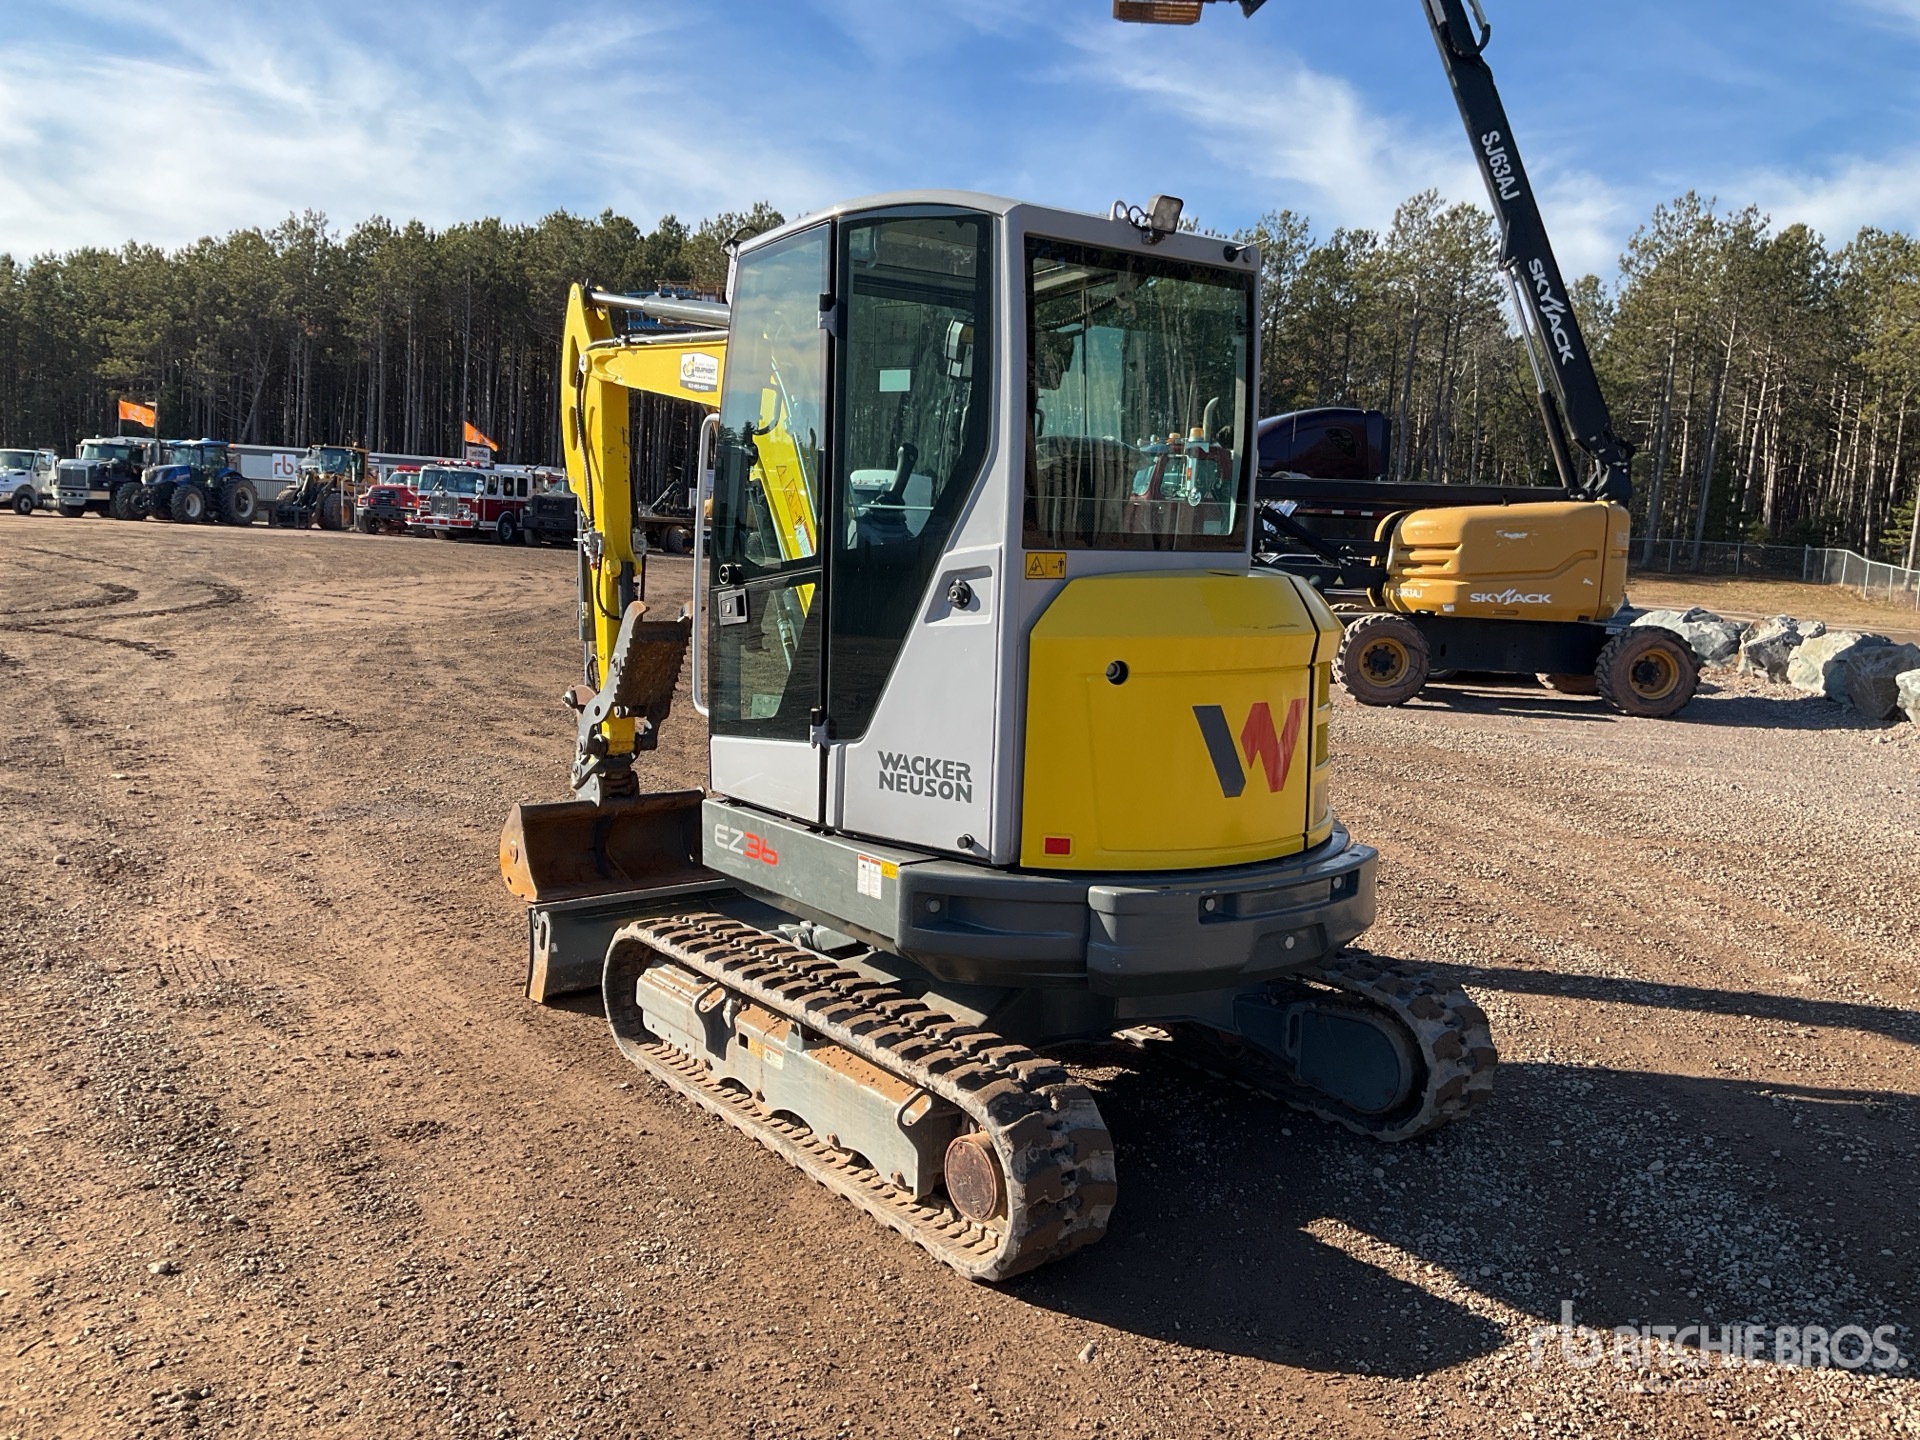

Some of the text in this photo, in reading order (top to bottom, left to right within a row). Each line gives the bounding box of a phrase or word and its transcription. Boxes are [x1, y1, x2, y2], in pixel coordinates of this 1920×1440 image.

[1481, 130, 1520, 201] SJ63AJ
[1528, 257, 1575, 366] SKYJACK
[274, 455, 294, 476] rb
[1470, 588, 1552, 605] SKYJACK
[877, 750, 973, 783] WACKER
[879, 770, 973, 803] NEUSON
[714, 823, 779, 867] EZ36
